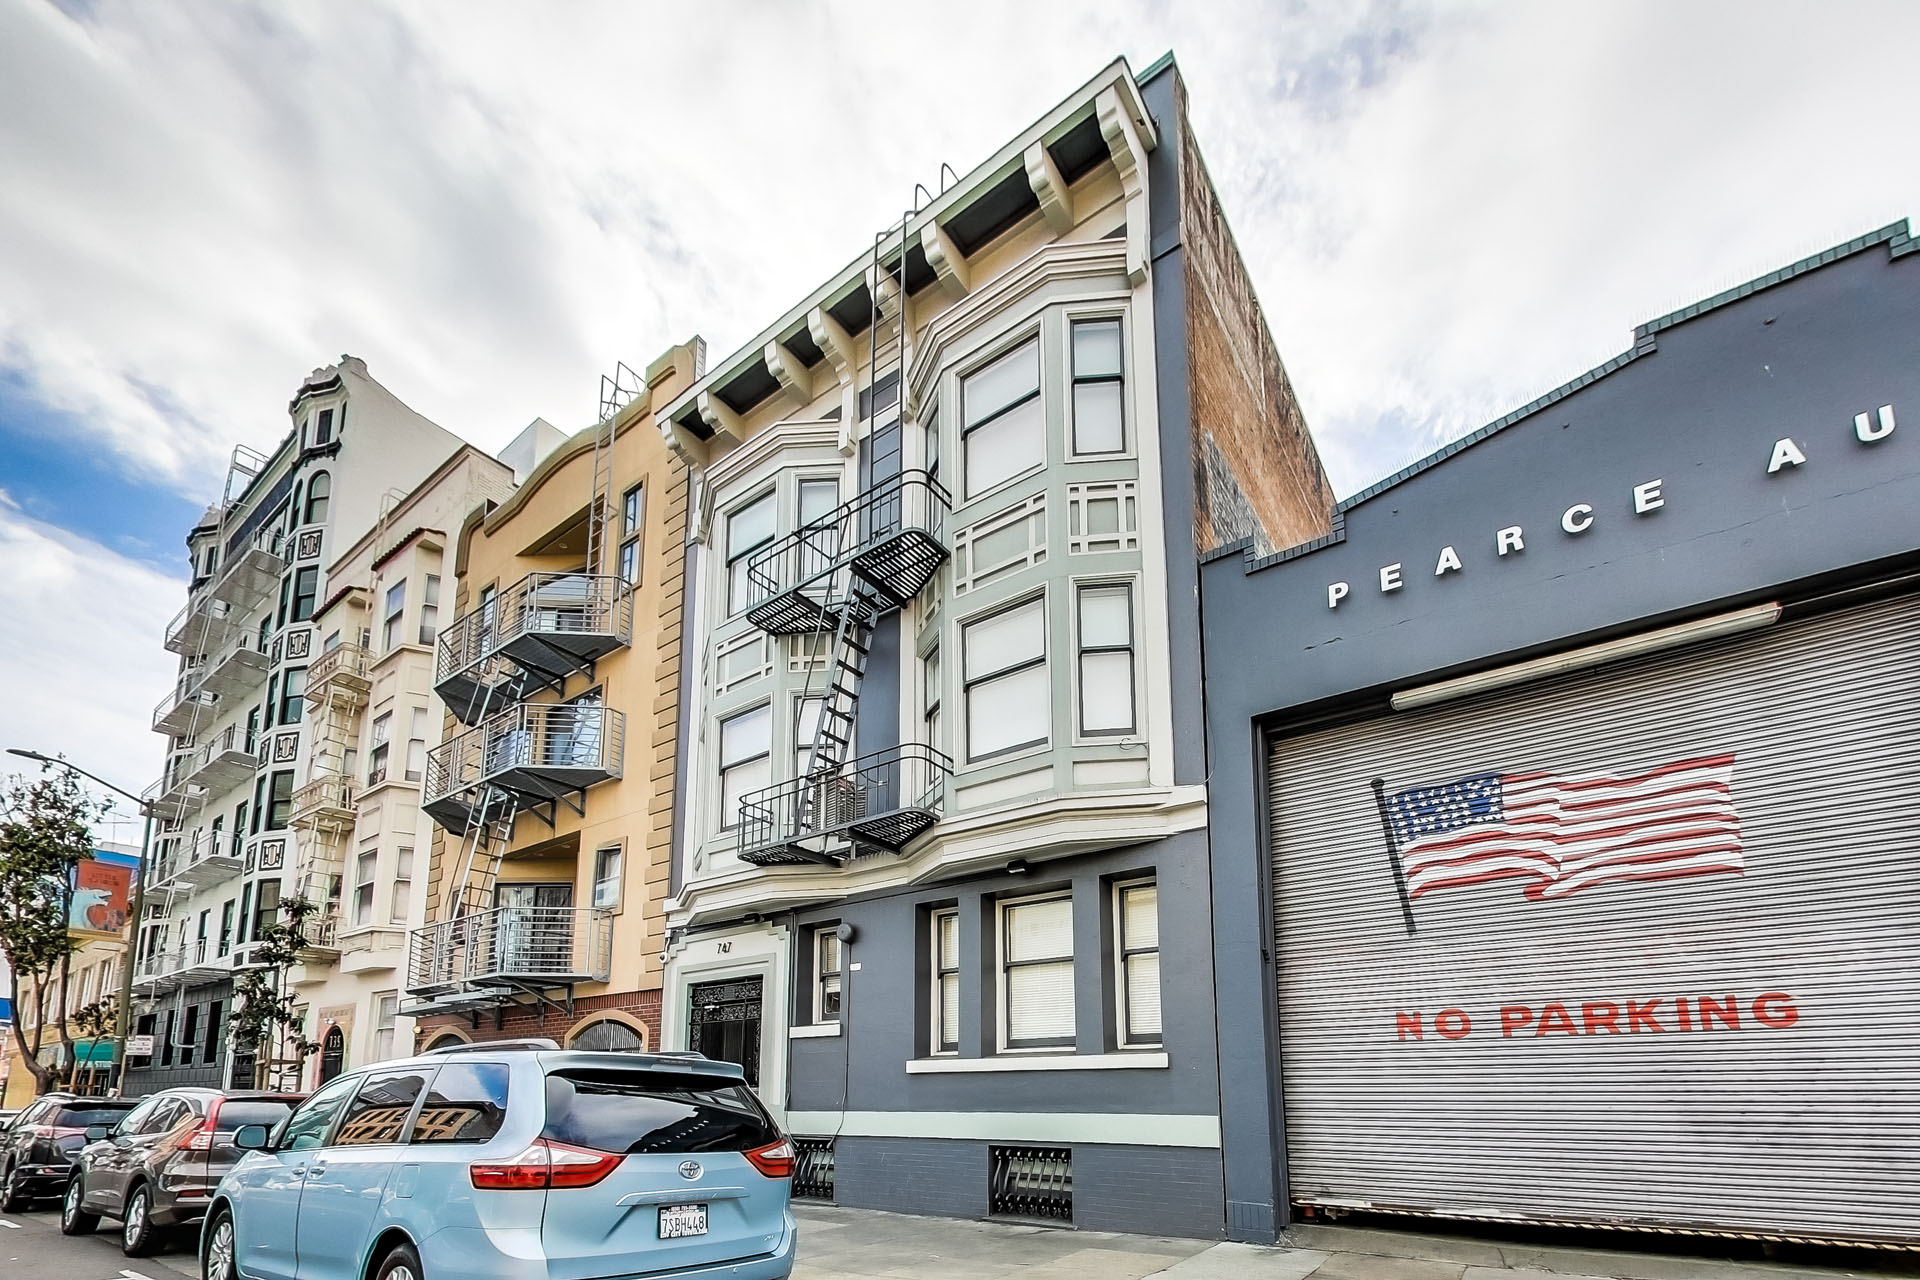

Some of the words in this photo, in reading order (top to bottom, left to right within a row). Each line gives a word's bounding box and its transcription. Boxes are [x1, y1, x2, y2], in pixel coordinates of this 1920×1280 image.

[1327, 478, 1666, 609] PEARCE
[1767, 404, 1896, 474] AU
[717, 941, 733, 955] 747
[1396, 1008, 1472, 1042] NO
[1501, 991, 1801, 1038] PARKING
[329, 1035, 342, 1048] 135
[662, 1215, 705, 1234] 7SBH448
